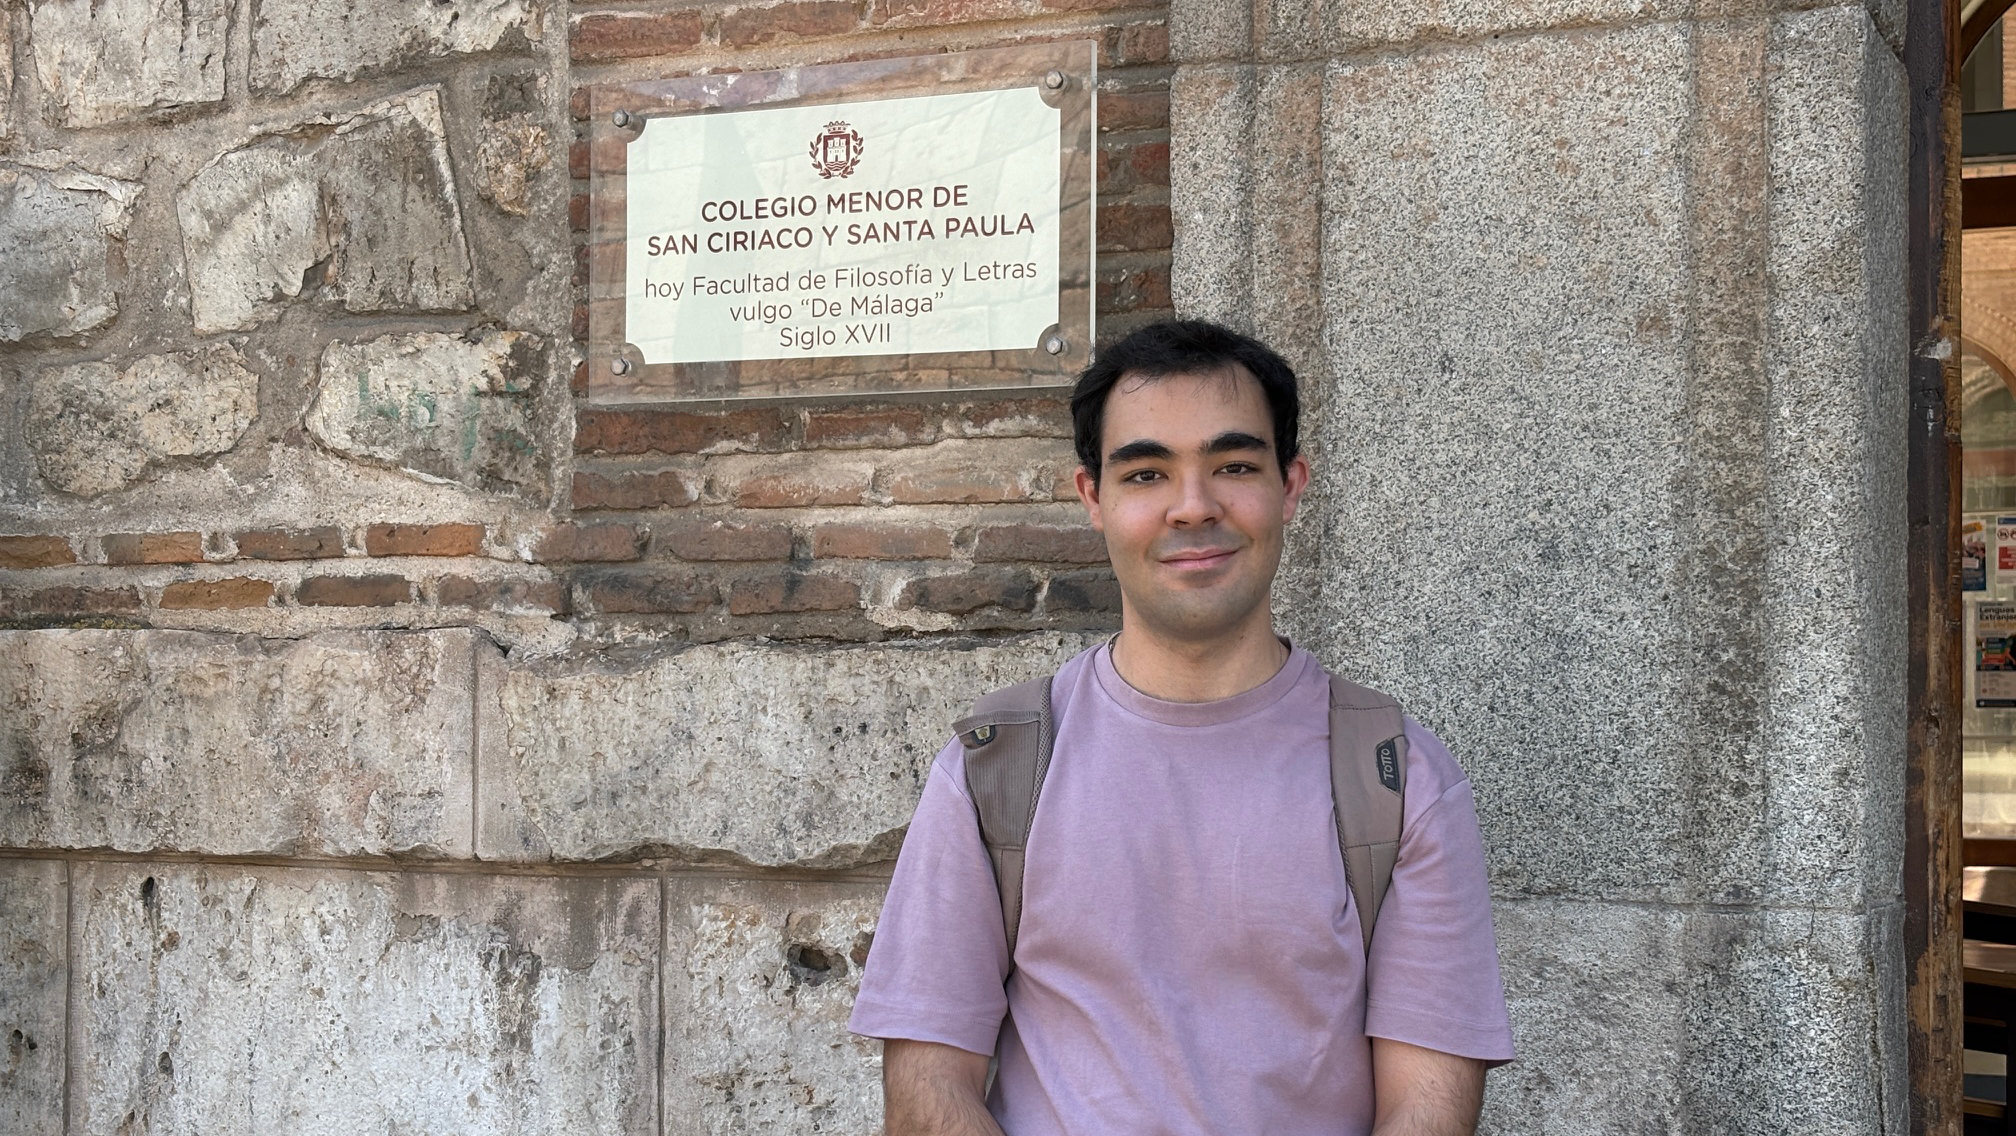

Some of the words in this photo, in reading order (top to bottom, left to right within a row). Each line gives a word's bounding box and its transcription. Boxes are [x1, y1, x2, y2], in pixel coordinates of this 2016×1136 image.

[701, 194, 817, 222] COLEGIO
[827, 188, 923, 214] MENOR
[934, 185, 968, 207] DE
[648, 234, 697, 256] SAN
[708, 227, 813, 253] CIRIACO
[822, 225, 838, 246] Y
[847, 219, 935, 245] SANTA
[946, 213, 1034, 239] PAULA
[646, 278, 684, 301] hoy
[694, 271, 789, 295] Facultad
[799, 270, 826, 290] de
[835, 263, 932, 288] Filosofía
[940, 267, 954, 288] y
[963, 260, 1037, 281] Letras
[729, 300, 793, 325] vulgo
[779, 325, 836, 351] Siglo
[845, 323, 890, 344] XVII
[1381, 748, 1394, 780] TOTTO
